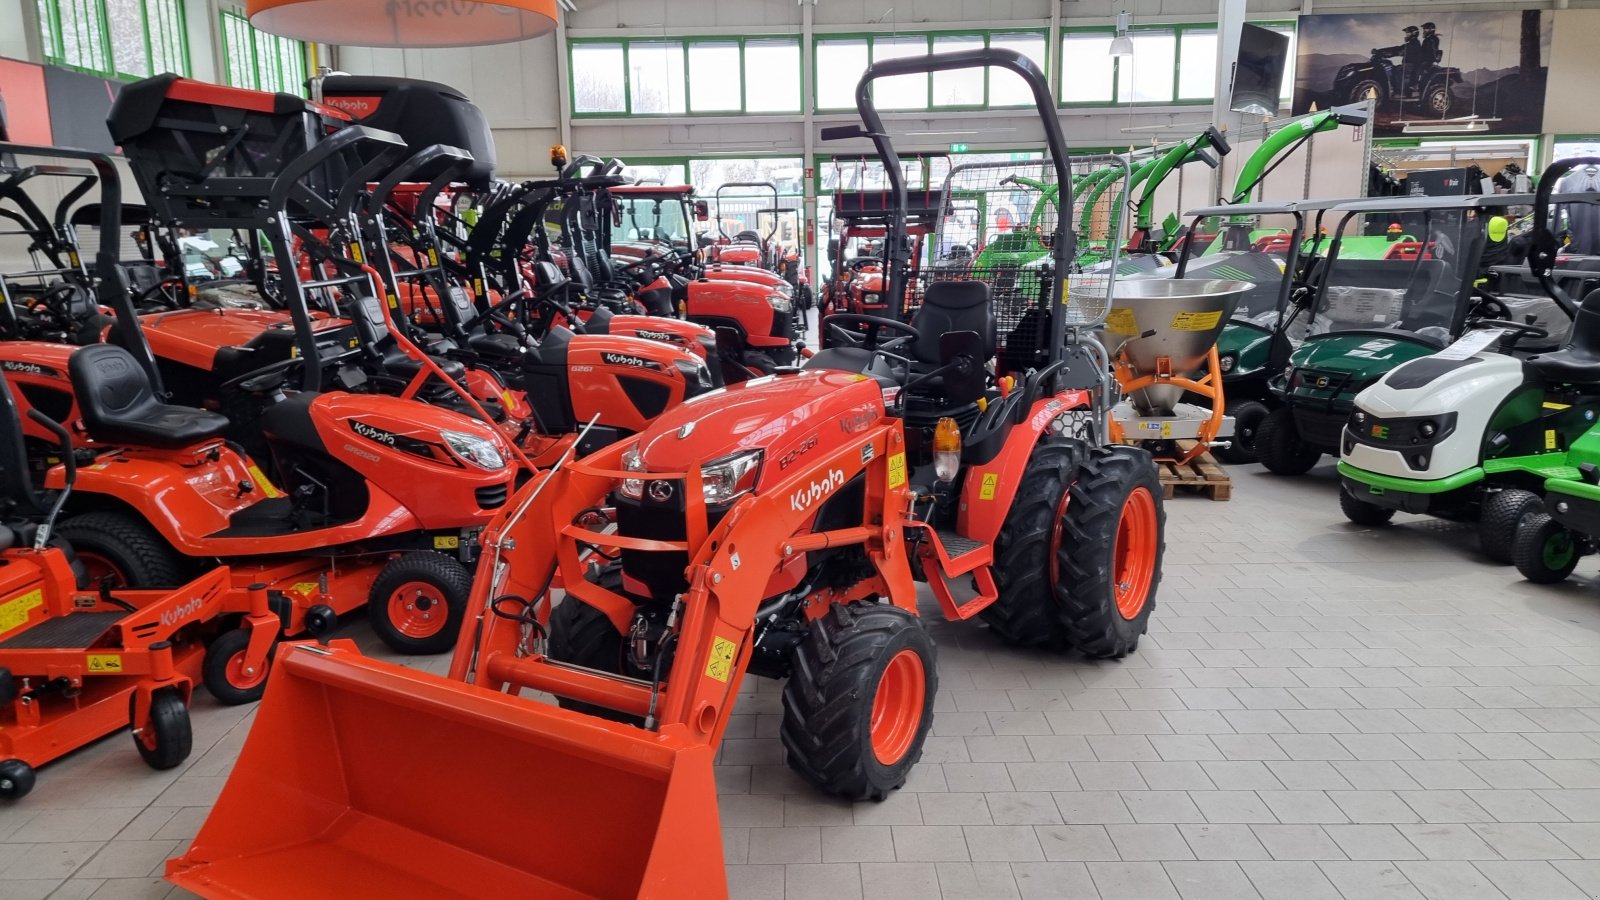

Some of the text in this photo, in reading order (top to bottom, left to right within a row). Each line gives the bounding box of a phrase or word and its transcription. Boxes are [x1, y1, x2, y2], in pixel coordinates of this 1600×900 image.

[327, 100, 369, 110] Kubota
[640, 330, 670, 340] Kubota
[606, 353, 643, 366] Kubota
[4, 361, 41, 373] Kubota
[354, 422, 396, 445] Kubota
[790, 469, 844, 511] Kubota
[160, 597, 203, 626] Kubota
